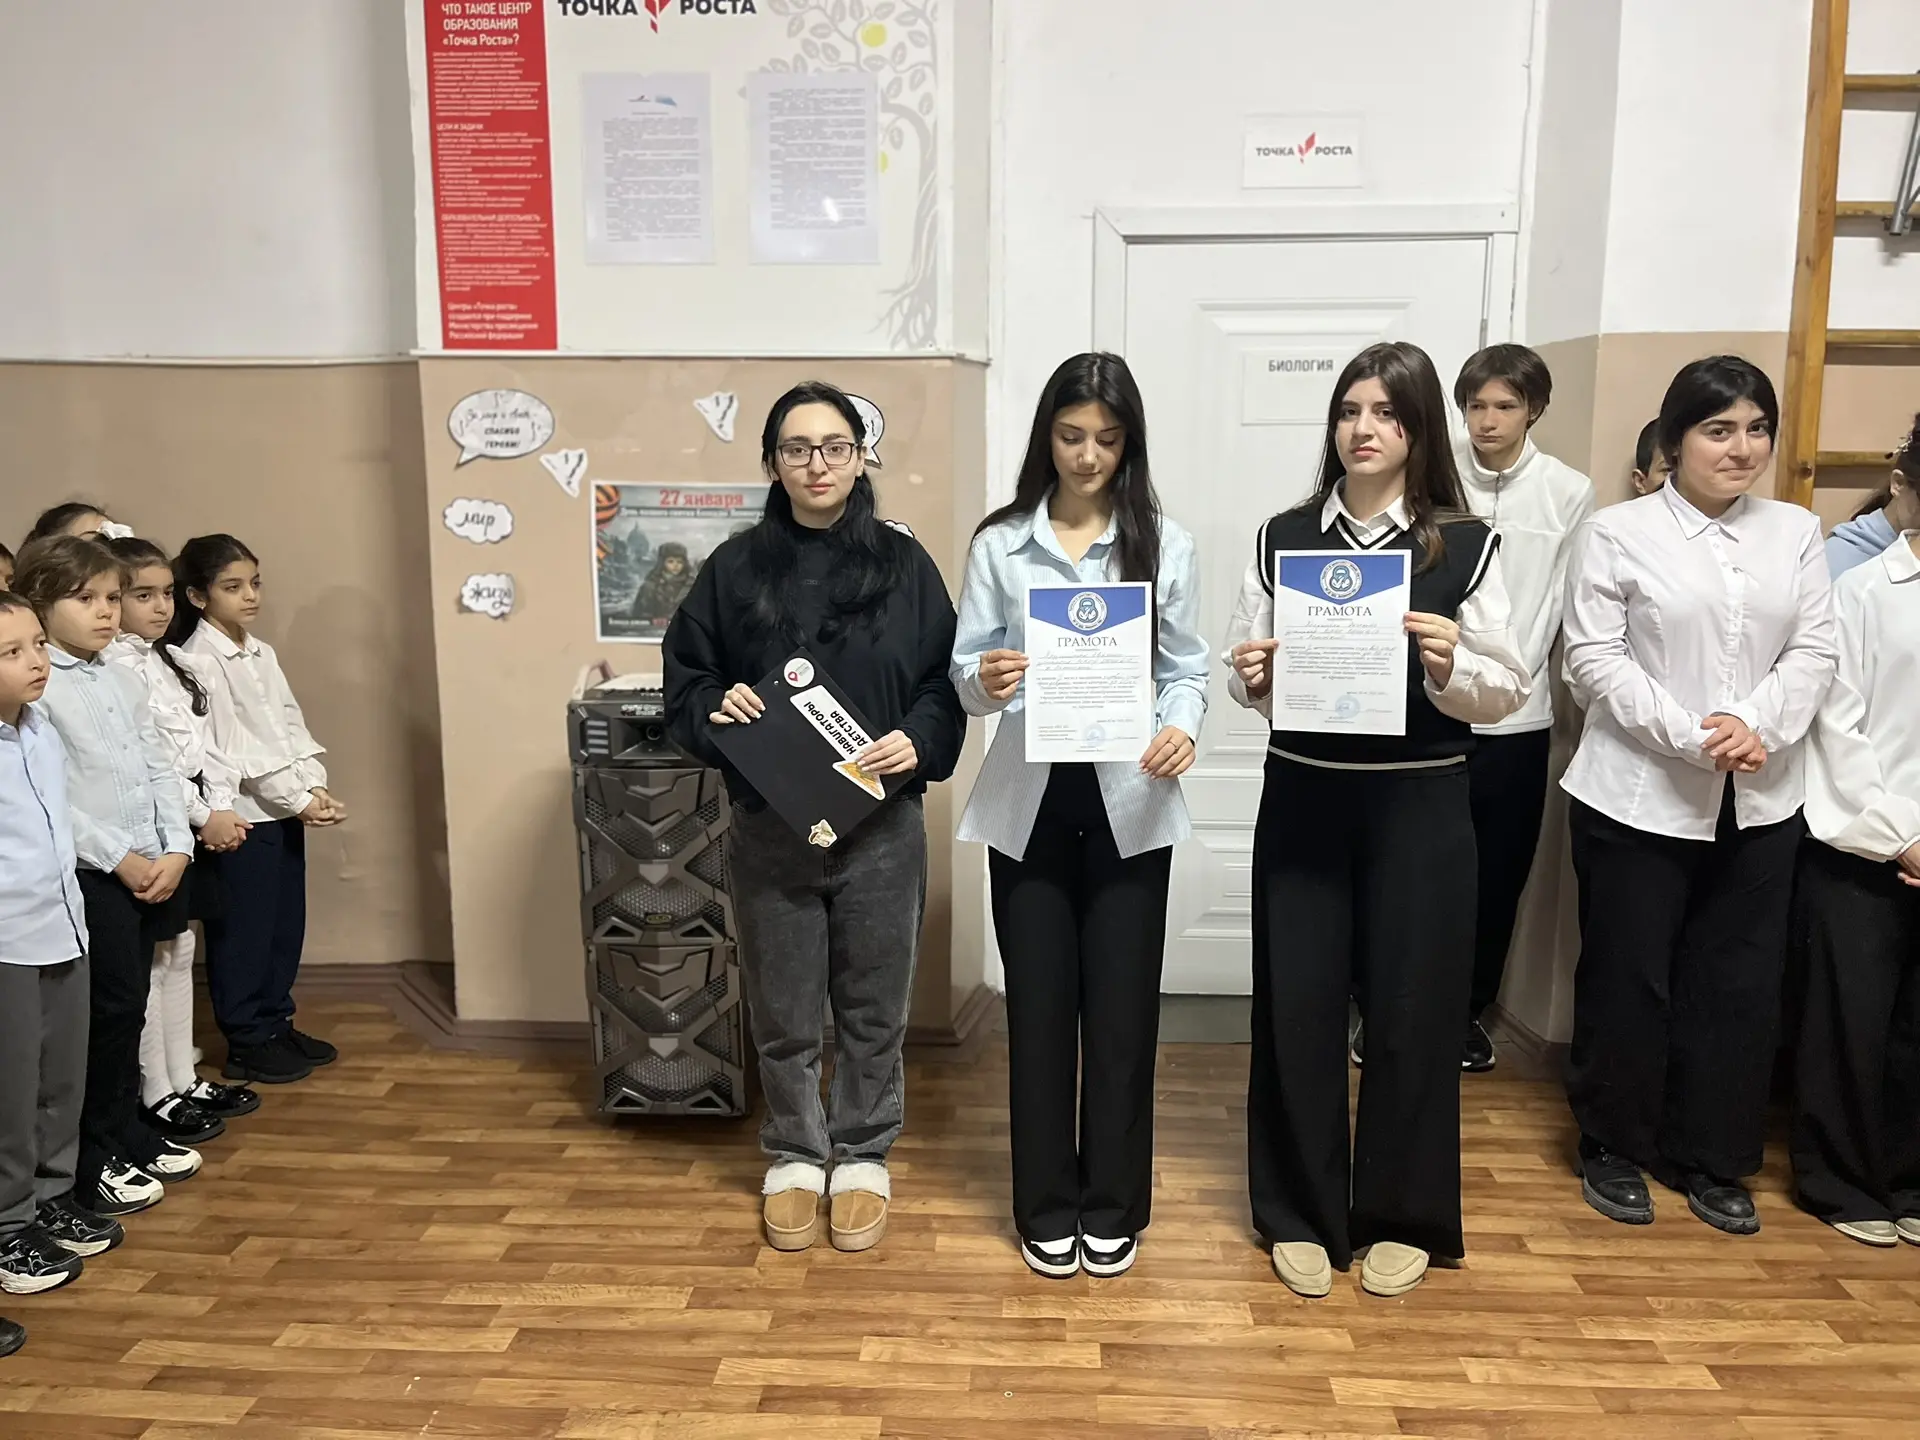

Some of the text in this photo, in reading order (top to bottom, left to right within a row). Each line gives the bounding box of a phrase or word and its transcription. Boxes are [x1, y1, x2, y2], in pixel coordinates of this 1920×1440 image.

[441, 2, 532, 16] ЧТО ТАКОЕ ЦЕНТР
[557, 0, 757, 16] ТОЧКА РОСТА
[443, 18, 518, 31] ОБРАЗОВАНИЯ
[442, 33, 520, 46] «Точка Роста»?
[1256, 146, 1353, 156] ТОЧКА РОСТА
[1268, 360, 1334, 372] БИОЛОГИЯ
[660, 490, 744, 509] 27 января
[454, 512, 495, 536] мир
[1308, 606, 1373, 617] ГРАМОТА
[1057, 637, 1118, 647] ГРАМОТА
[803, 702, 856, 755] НАВИГАТОРЫ
[831, 710, 869, 747] ДЕТСТВА
